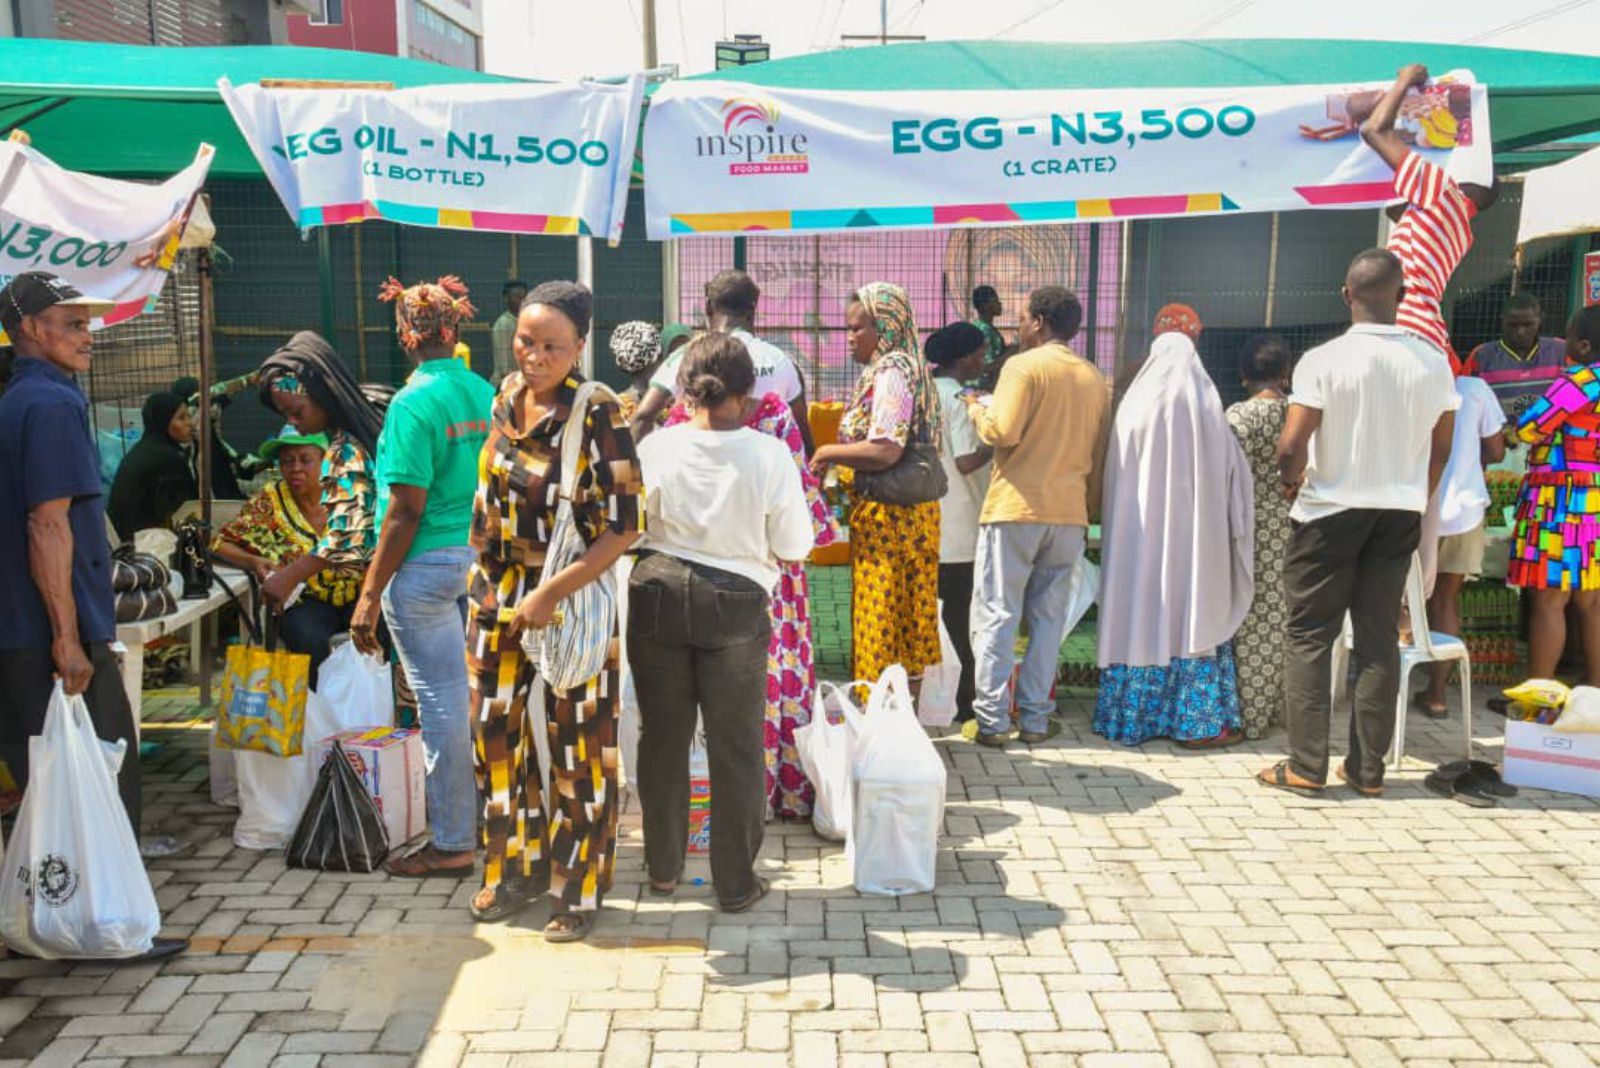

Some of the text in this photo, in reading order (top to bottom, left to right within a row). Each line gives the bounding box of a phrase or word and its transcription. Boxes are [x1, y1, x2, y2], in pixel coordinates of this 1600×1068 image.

[696, 125, 808, 163] inspire
[892, 117, 1004, 154] EGG
[1050, 105, 1256, 149] N3,500
[354, 124, 408, 155] OIL
[447, 131, 609, 167] N1,500
[362, 163, 485, 187] (1 BOTTLE)
[734, 164, 805, 174] FOOD MARKET
[1002, 156, 1117, 177] (1 CRATE)
